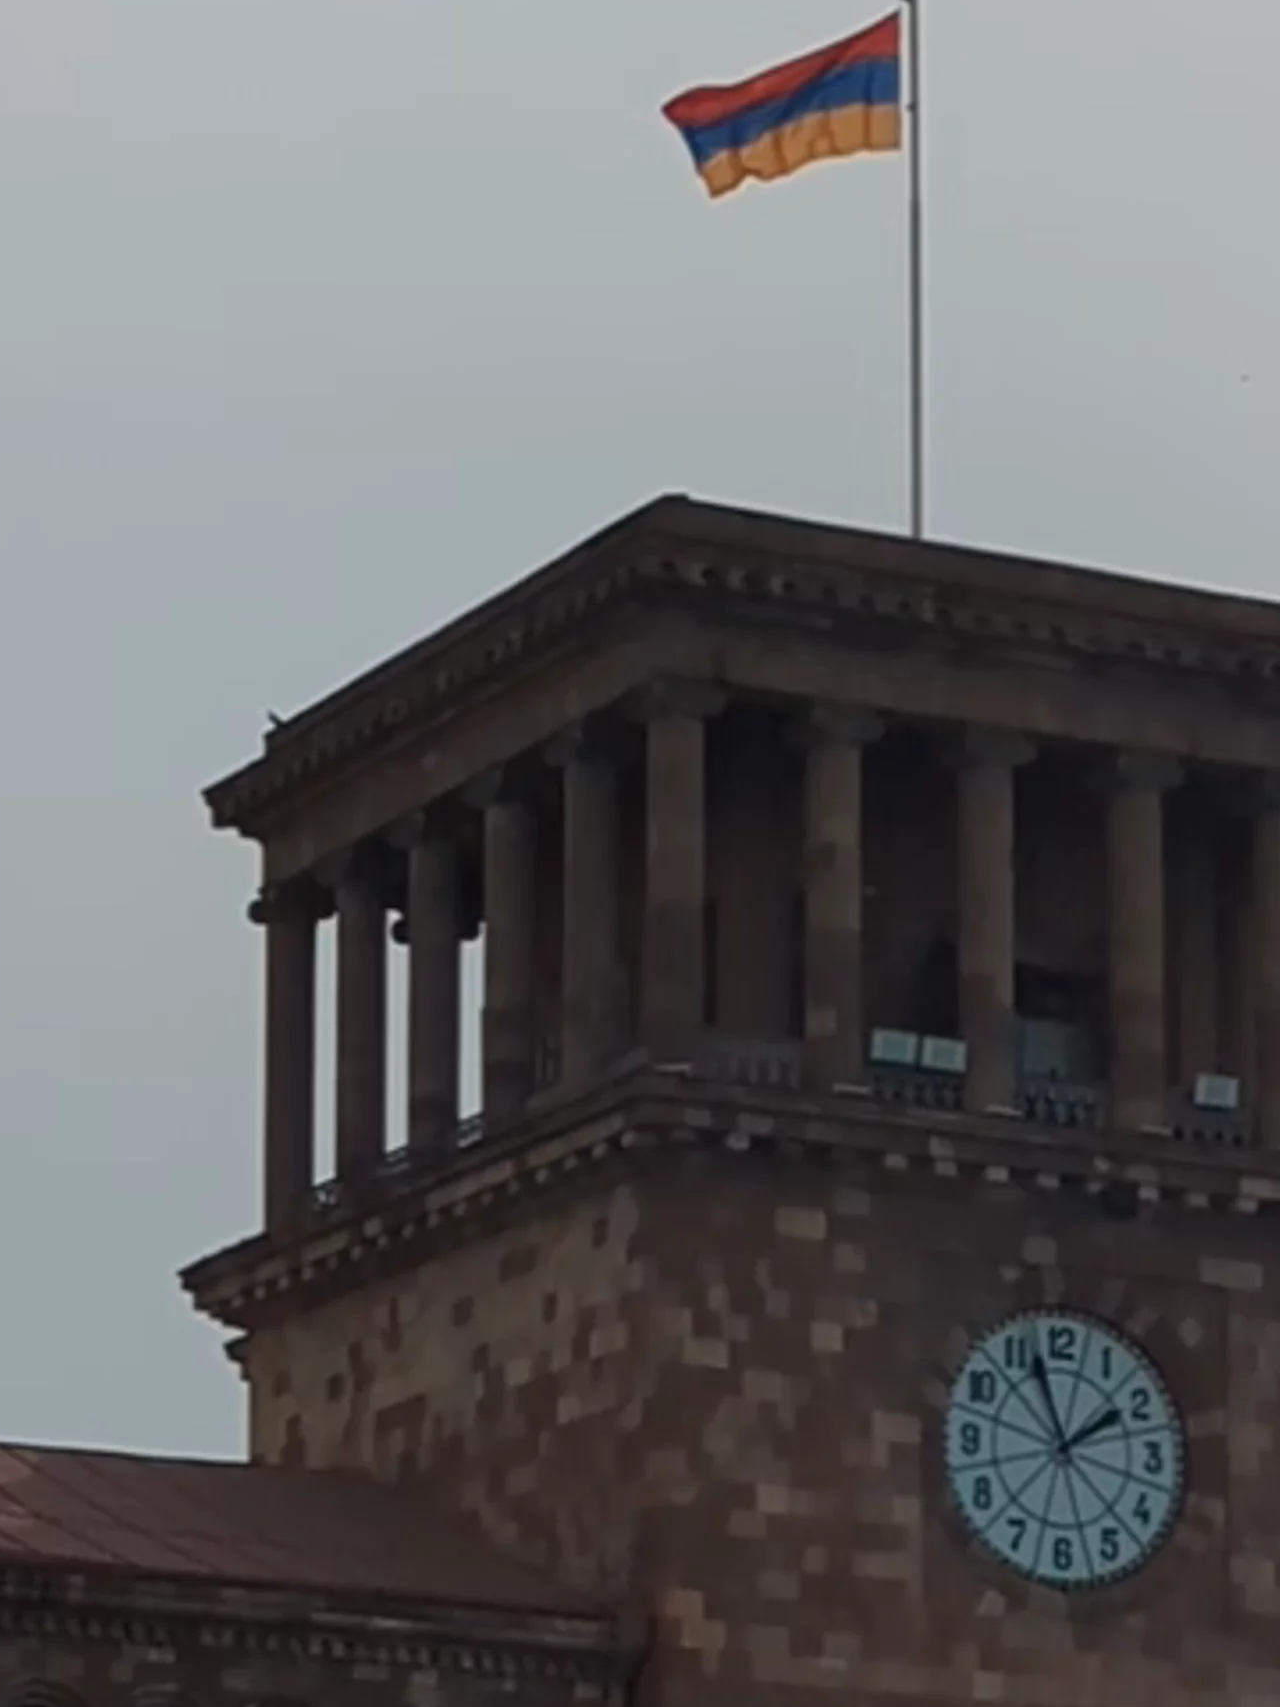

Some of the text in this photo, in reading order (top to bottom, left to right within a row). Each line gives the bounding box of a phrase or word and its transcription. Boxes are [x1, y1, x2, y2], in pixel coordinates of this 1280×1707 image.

[1005, 1336, 1026, 1369] 11
[1048, 1326, 1075, 1360] 12
[1101, 1346, 1111, 1379] 1
[970, 1370, 995, 1404] 10
[1131, 1389, 1150, 1421] 2
[961, 1423, 980, 1455] 9
[1143, 1442, 1163, 1474] 3
[973, 1477, 992, 1510] 8
[1132, 1493, 1150, 1525] 4
[1007, 1518, 1026, 1551] 7
[1100, 1528, 1119, 1561] 5
[1053, 1537, 1073, 1570] 6
